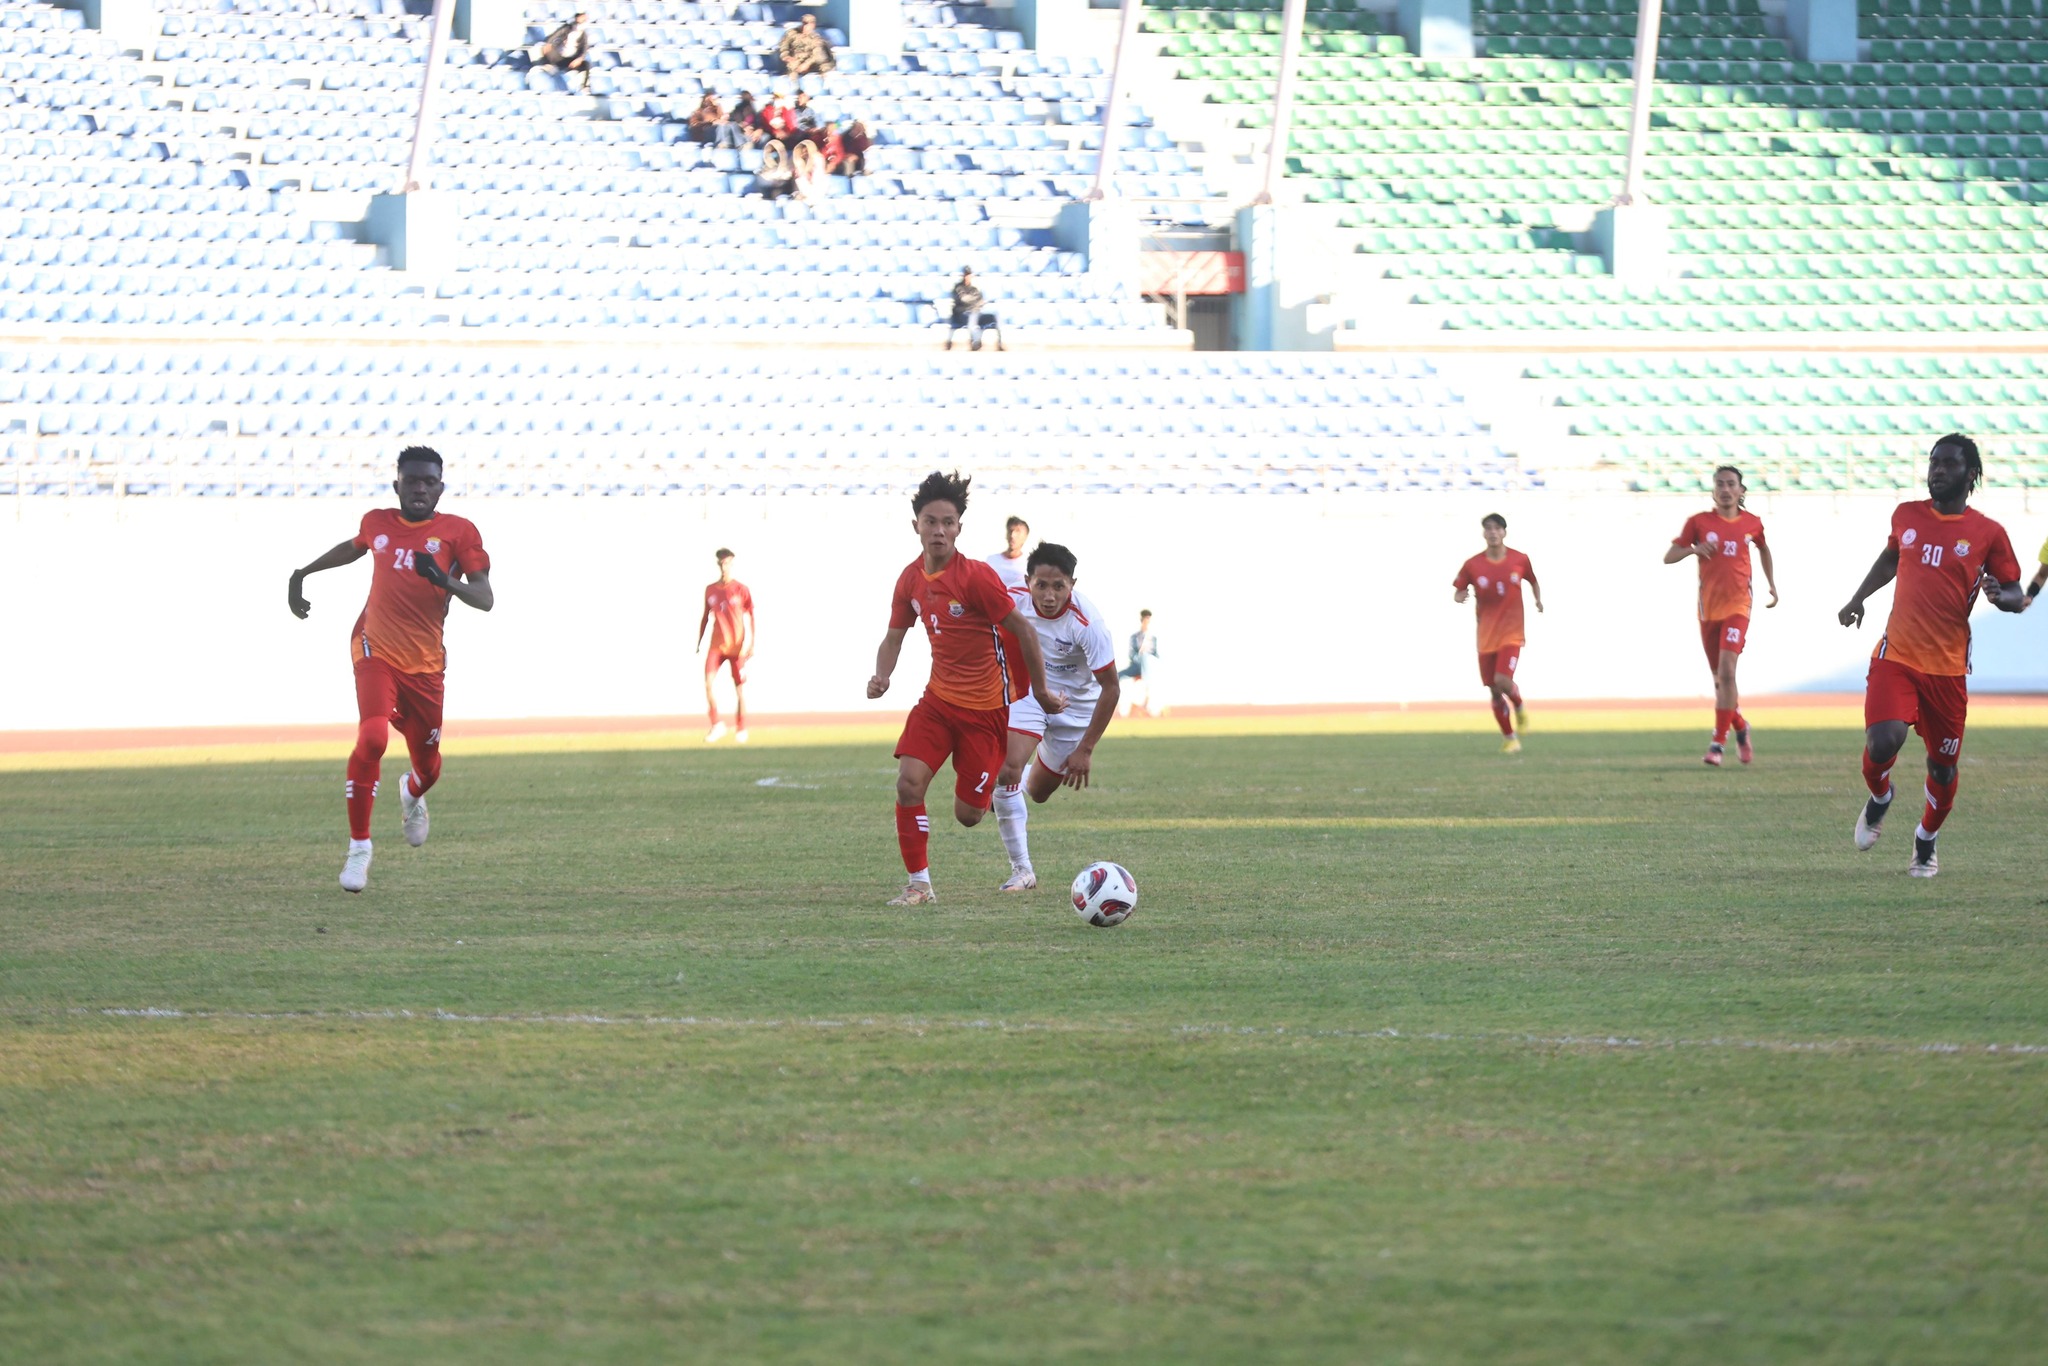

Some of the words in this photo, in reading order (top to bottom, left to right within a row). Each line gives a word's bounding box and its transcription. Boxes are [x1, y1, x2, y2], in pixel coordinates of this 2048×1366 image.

[393, 547, 414, 570] 24
[1723, 540, 1737, 557] 23
[1922, 543, 1943, 567] 30
[930, 614, 942, 634] 2
[1726, 626, 1740, 643] 23
[1939, 738, 1959, 755] 30
[974, 771, 989, 793] 2
